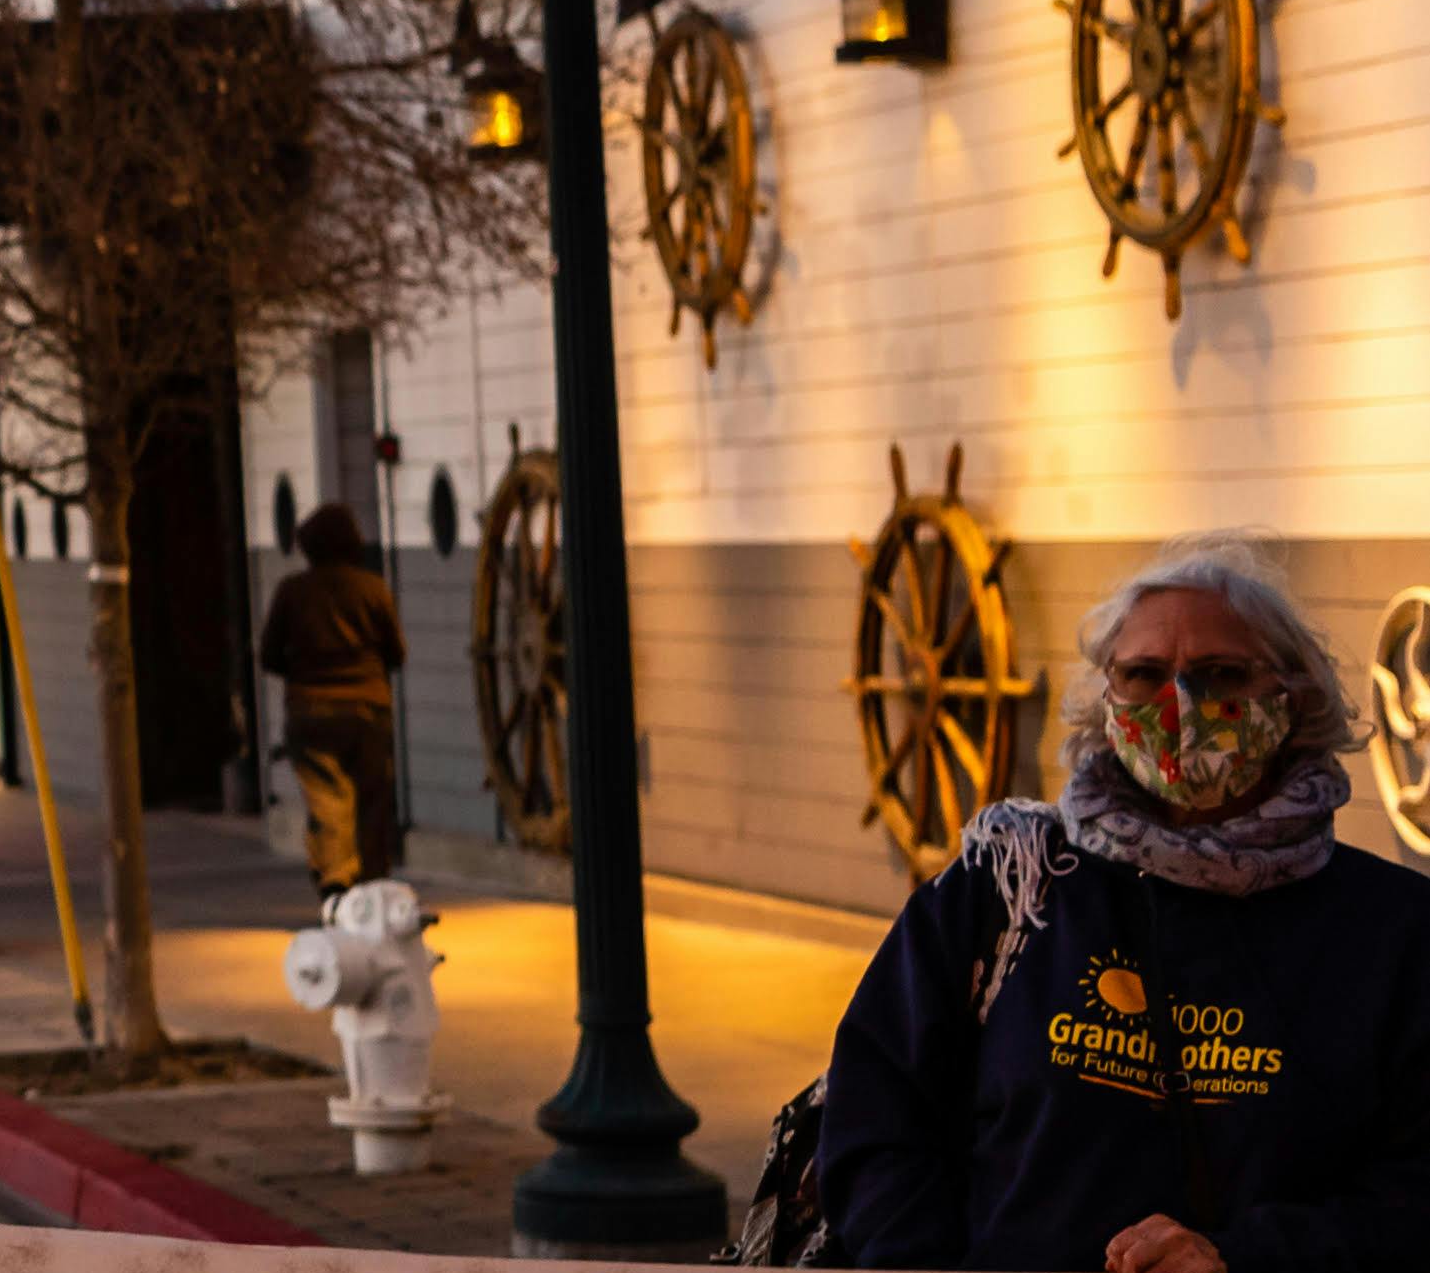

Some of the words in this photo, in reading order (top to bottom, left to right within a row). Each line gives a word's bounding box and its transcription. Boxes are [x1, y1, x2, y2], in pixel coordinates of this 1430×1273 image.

[1171, 1003, 1245, 1037] 1000
[1050, 1045, 1079, 1068] for
[1084, 1051, 1149, 1084] Future
